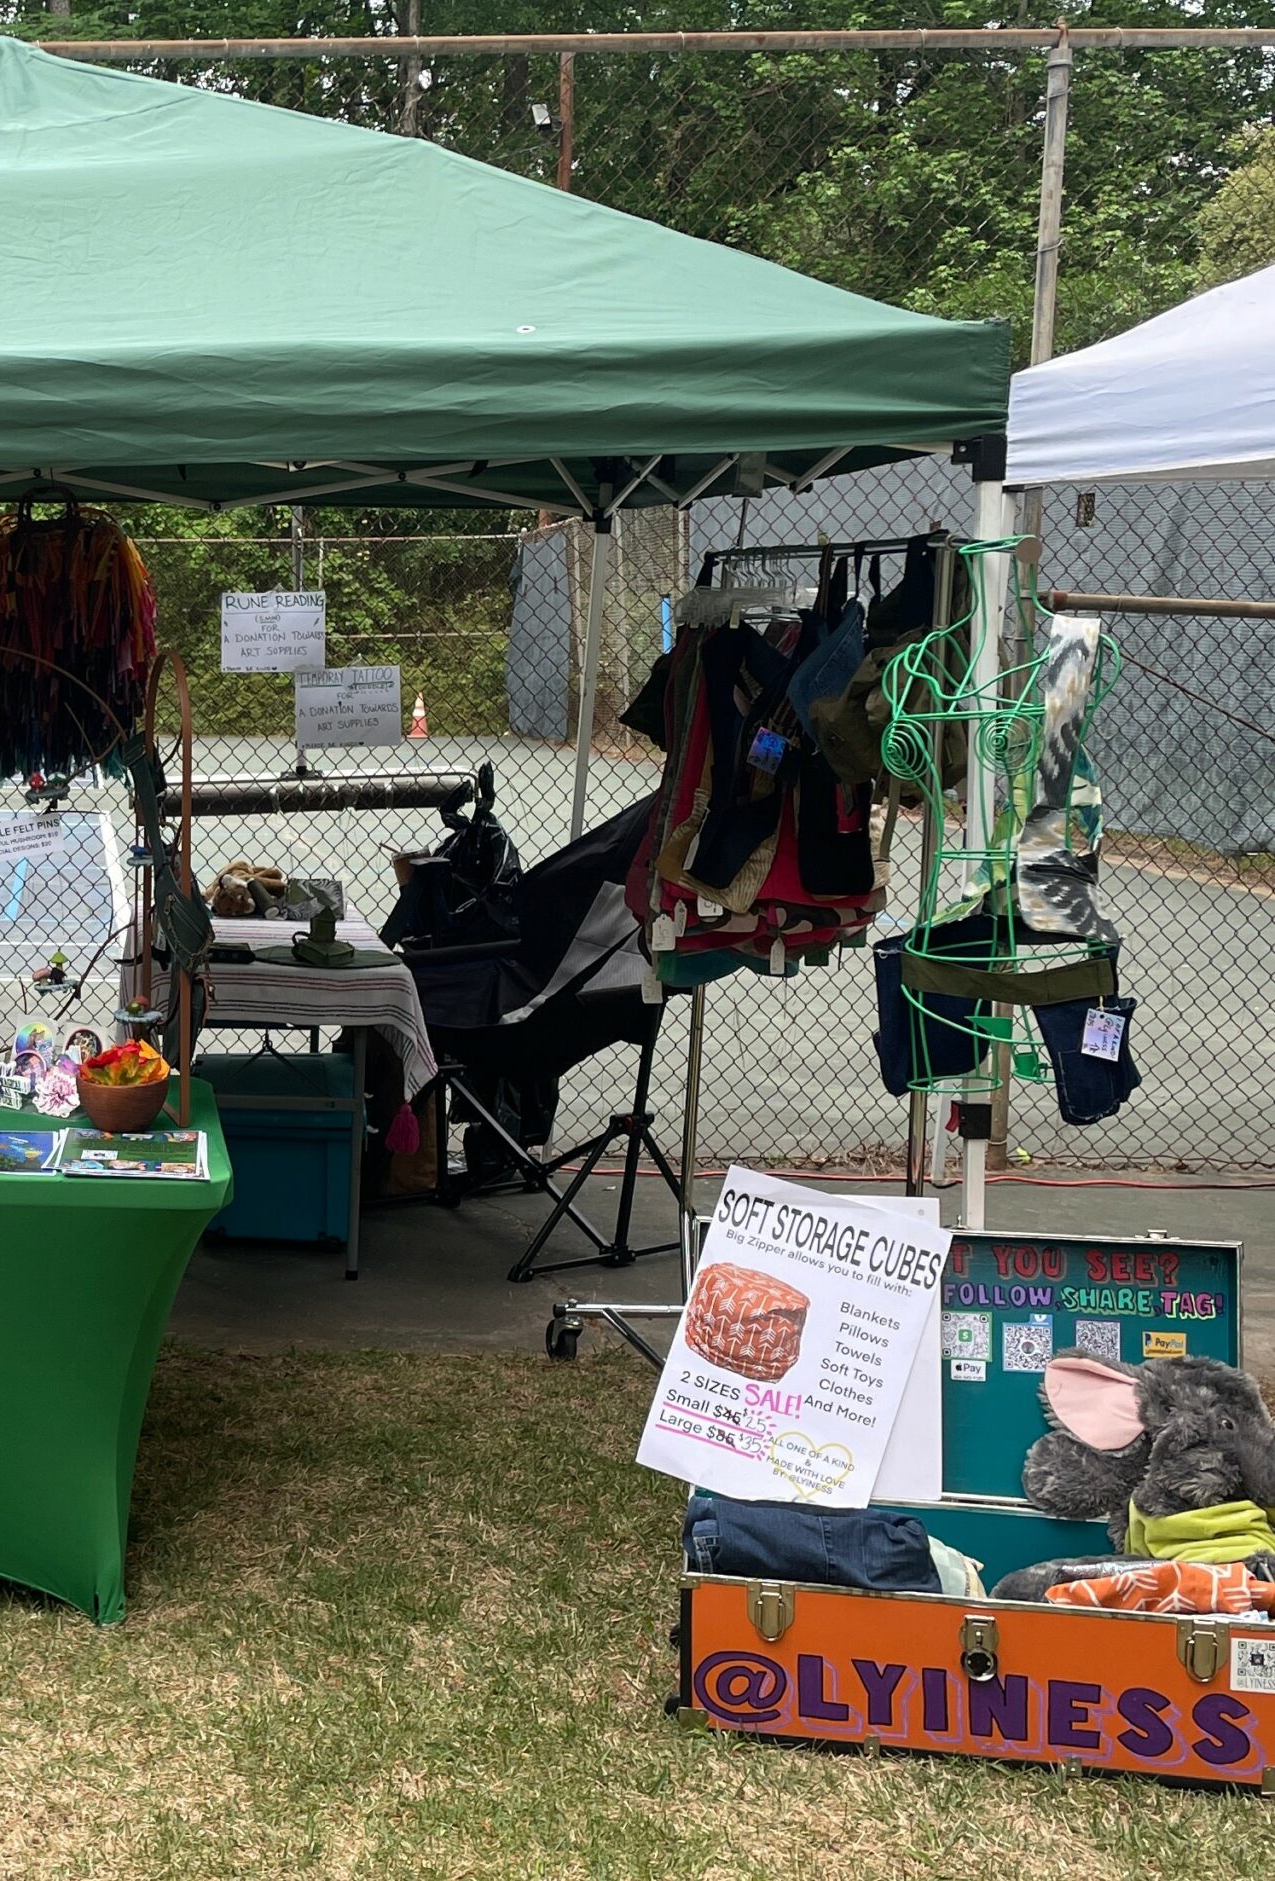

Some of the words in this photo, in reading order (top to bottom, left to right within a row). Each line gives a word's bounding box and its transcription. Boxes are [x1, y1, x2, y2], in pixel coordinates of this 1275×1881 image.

[225, 595, 269, 610] RUNE
[275, 594, 325, 612] READING
[235, 632, 286, 643] DONATION
[262, 624, 280, 632] FOR
[240, 648, 261, 657] ART
[266, 646, 308, 656] SUPPLIES
[352, 667, 393, 683] TATTOO
[299, 708, 305, 717] A
[309, 705, 354, 717] DONATION
[360, 703, 399, 714] TOWARDS
[317, 722, 333, 731] ART
[337, 717, 379, 729] SUPPLIES
[13, 823, 35, 836] FELT
[37, 818, 60, 832] PINS
[718, 1188, 775, 1233] SOFT
[771, 1204, 869, 1266] STORAGE
[868, 1236, 942, 1290] CUBES
[725, 1229, 744, 1245] Big
[747, 1236, 786, 1258] Zipper
[787, 1247, 825, 1270] allows
[827, 1262, 850, 1277] you
[852, 1268, 864, 1281] to
[866, 1271, 882, 1289] fill
[883, 1278, 912, 1297] with:
[992, 1245, 1064, 1279] YOU
[1085, 1249, 1180, 1286] SEE?
[840, 1301, 900, 1331] Blankets
[1161, 1291, 1225, 1319] TAG!
[839, 1322, 889, 1348] Pillows
[835, 1341, 883, 1367] Towels
[821, 1358, 848, 1379] Soft
[850, 1367, 884, 1389] Toys
[964, 1363, 982, 1374] Pay
[680, 1370, 691, 1384] 2
[694, 1375, 741, 1401] SIZES
[818, 1378, 873, 1406] Clothes
[666, 1389, 710, 1414] Small
[744, 1383, 803, 1420] SALE!
[804, 1394, 833, 1414] And
[835, 1404, 877, 1428] More!
[659, 1409, 703, 1434] Large
[742, 1407, 767, 1433] $25
[738, 1433, 763, 1454] $35
[768, 1436, 784, 1448] ALL
[786, 1442, 807, 1456] ONE
[808, 1450, 821, 1460] OF
[823, 1455, 831, 1463] A
[831, 1458, 855, 1472] KIND
[766, 1455, 793, 1471] MADE
[794, 1466, 819, 1480] WITH
[820, 1476, 845, 1489] LOVE
[804, 1459, 812, 1467] &
[788, 1474, 833, 1495] @LYINESS
[694, 1650, 1255, 1768] @LYINESS
